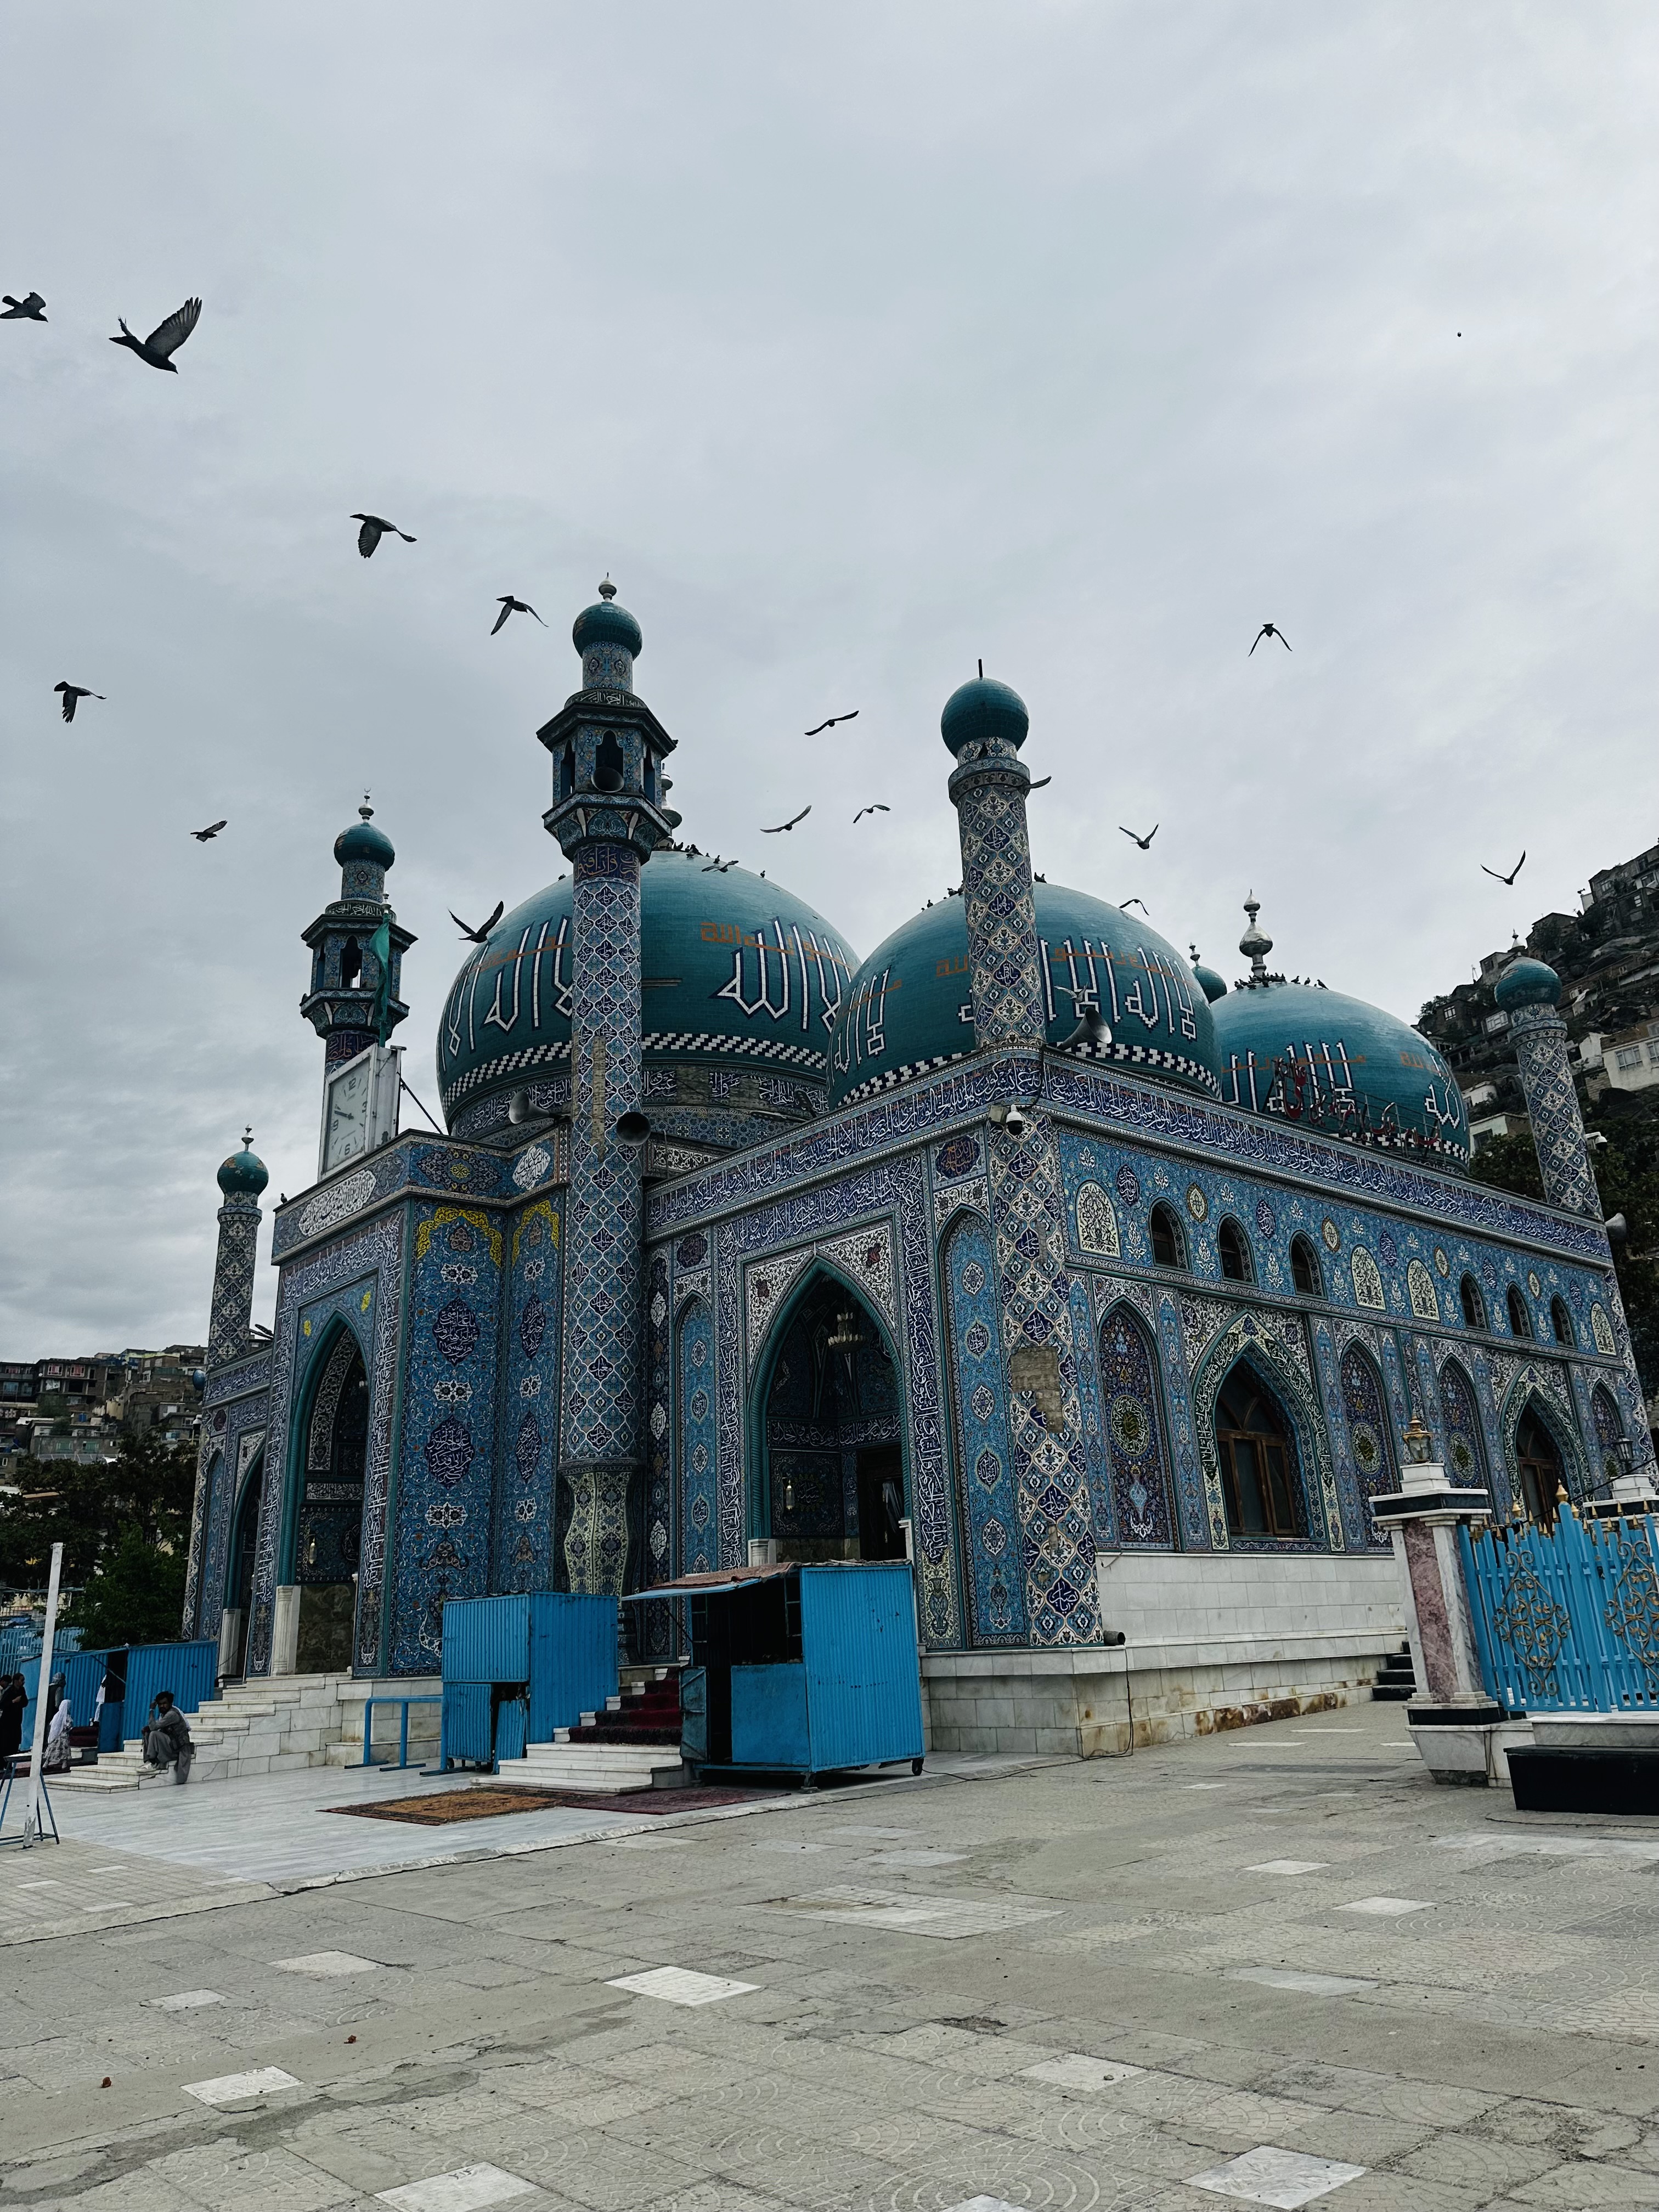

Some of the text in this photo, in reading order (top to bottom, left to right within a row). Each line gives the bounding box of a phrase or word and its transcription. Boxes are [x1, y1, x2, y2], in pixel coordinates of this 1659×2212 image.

[348, 1077, 357, 1091] 12
[362, 1101, 368, 1113] 3
[332, 1119, 339, 1132] 9
[344, 1143, 351, 1156] 6
